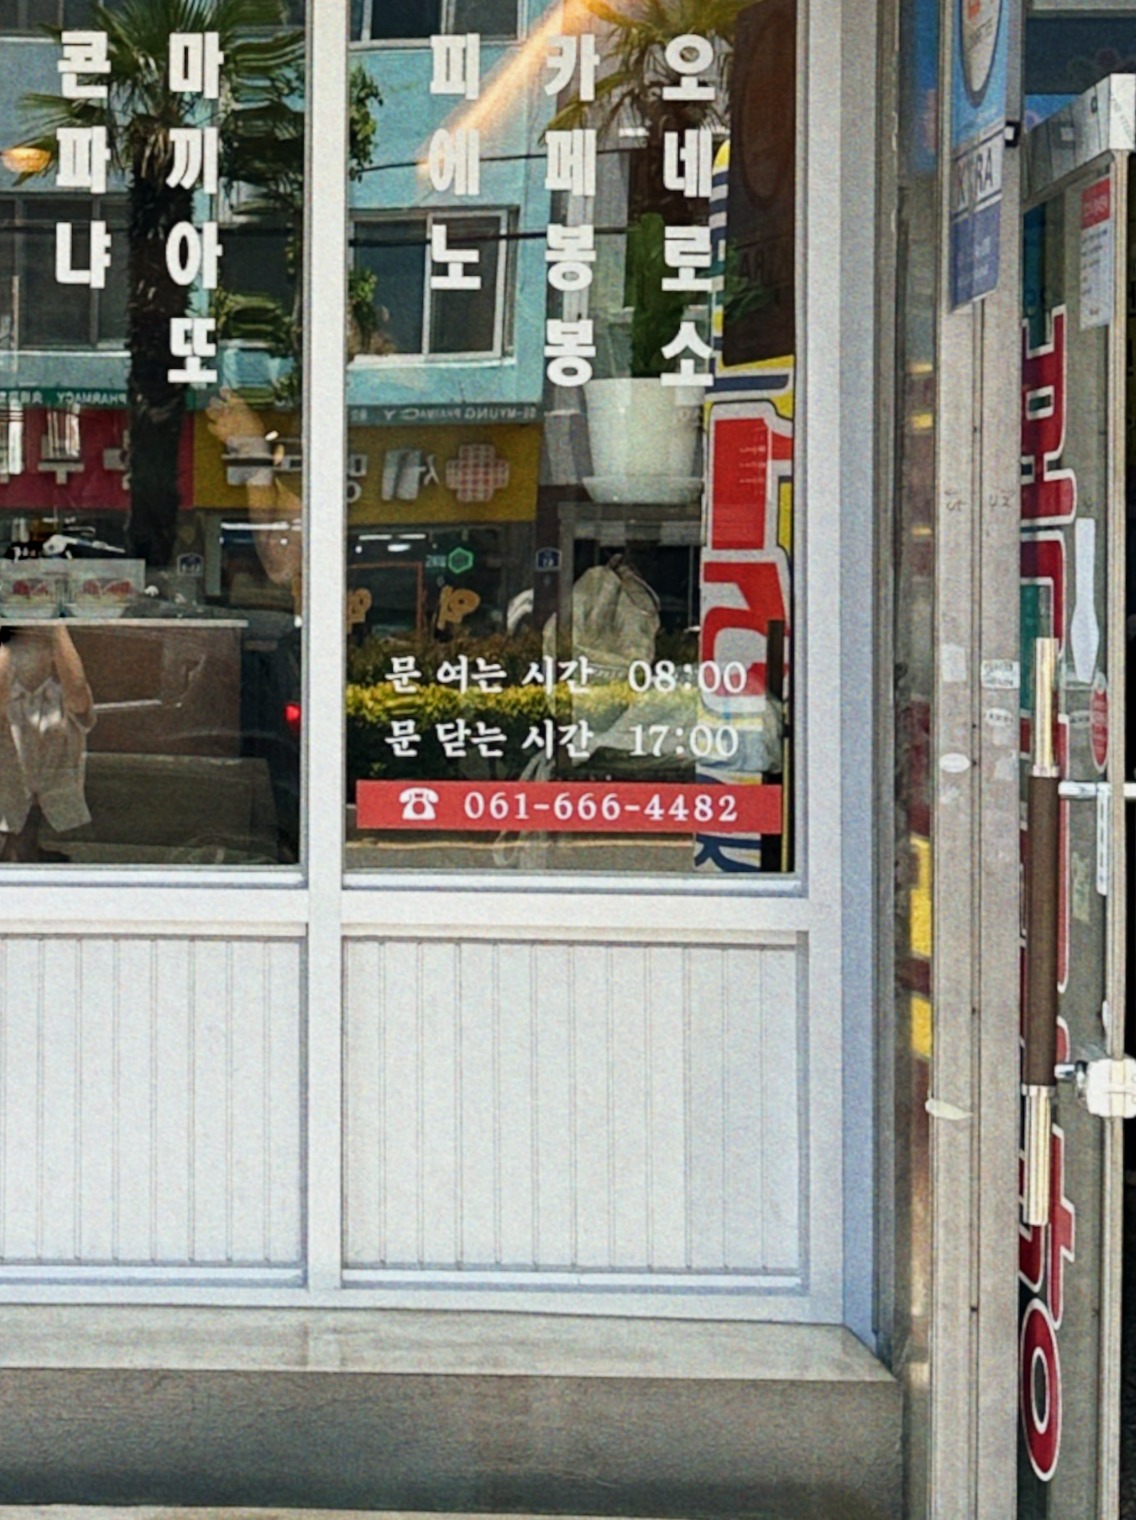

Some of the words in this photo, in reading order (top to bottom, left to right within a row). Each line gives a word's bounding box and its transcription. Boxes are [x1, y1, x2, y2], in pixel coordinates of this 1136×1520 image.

[55, 31, 112, 289] 콘파냐
[165, 30, 224, 383] 마끼아또
[429, 32, 482, 291] 피에노
[543, 33, 601, 387] 카페봉봉
[660, 33, 716, 387] 오네로소
[384, 655, 422, 694] 문
[435, 655, 507, 695] 여는
[521, 655, 596, 695] 시간
[627, 659, 748, 694] 08:00
[384, 720, 422, 758] 문
[435, 720, 507, 758] 닫는
[521, 719, 595, 759] 시간
[629, 724, 739, 758] 17:00
[463, 792, 739, 821] 061-666-4482
